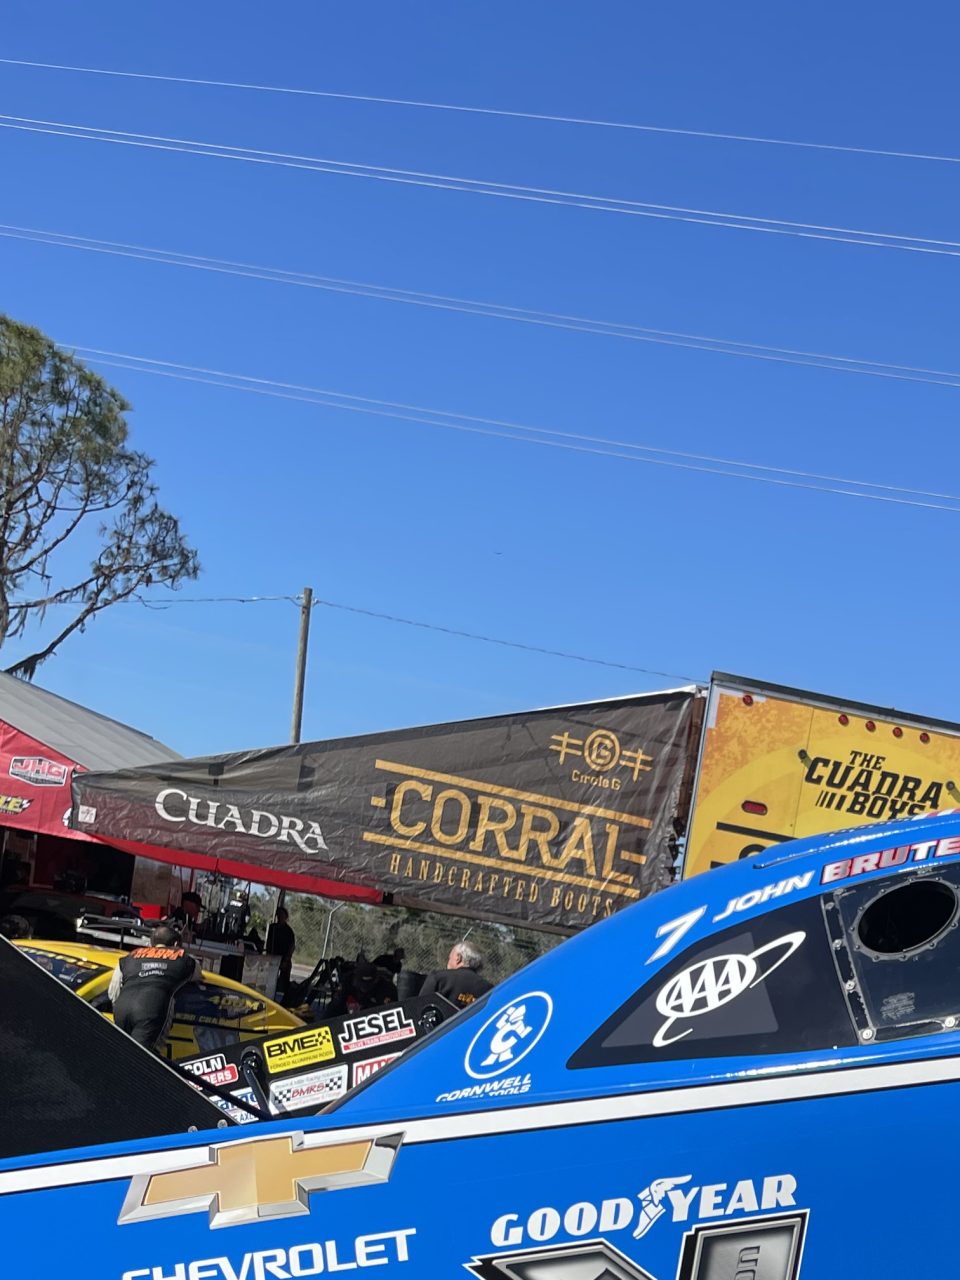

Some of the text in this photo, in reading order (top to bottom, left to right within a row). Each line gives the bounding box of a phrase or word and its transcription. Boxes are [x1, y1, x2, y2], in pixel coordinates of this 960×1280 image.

[850, 750, 886, 770] THE
[805, 756, 943, 809] CUADRA
[155, 788, 330, 854] CUADRA
[845, 791, 926, 821] BOYS
[389, 779, 635, 884] CORRAL
[389, 853, 614, 917] HANDCRAFTED BOOTS
[645, 905, 708, 966] 7
[712, 869, 815, 923] JOHN
[669, 955, 750, 1016] AAA
[266, 1034, 319, 1058] BME
[340, 1010, 412, 1043] JESEL
[291, 1082, 325, 1099] BMRS
[435, 1073, 532, 1103] CORNWELL
